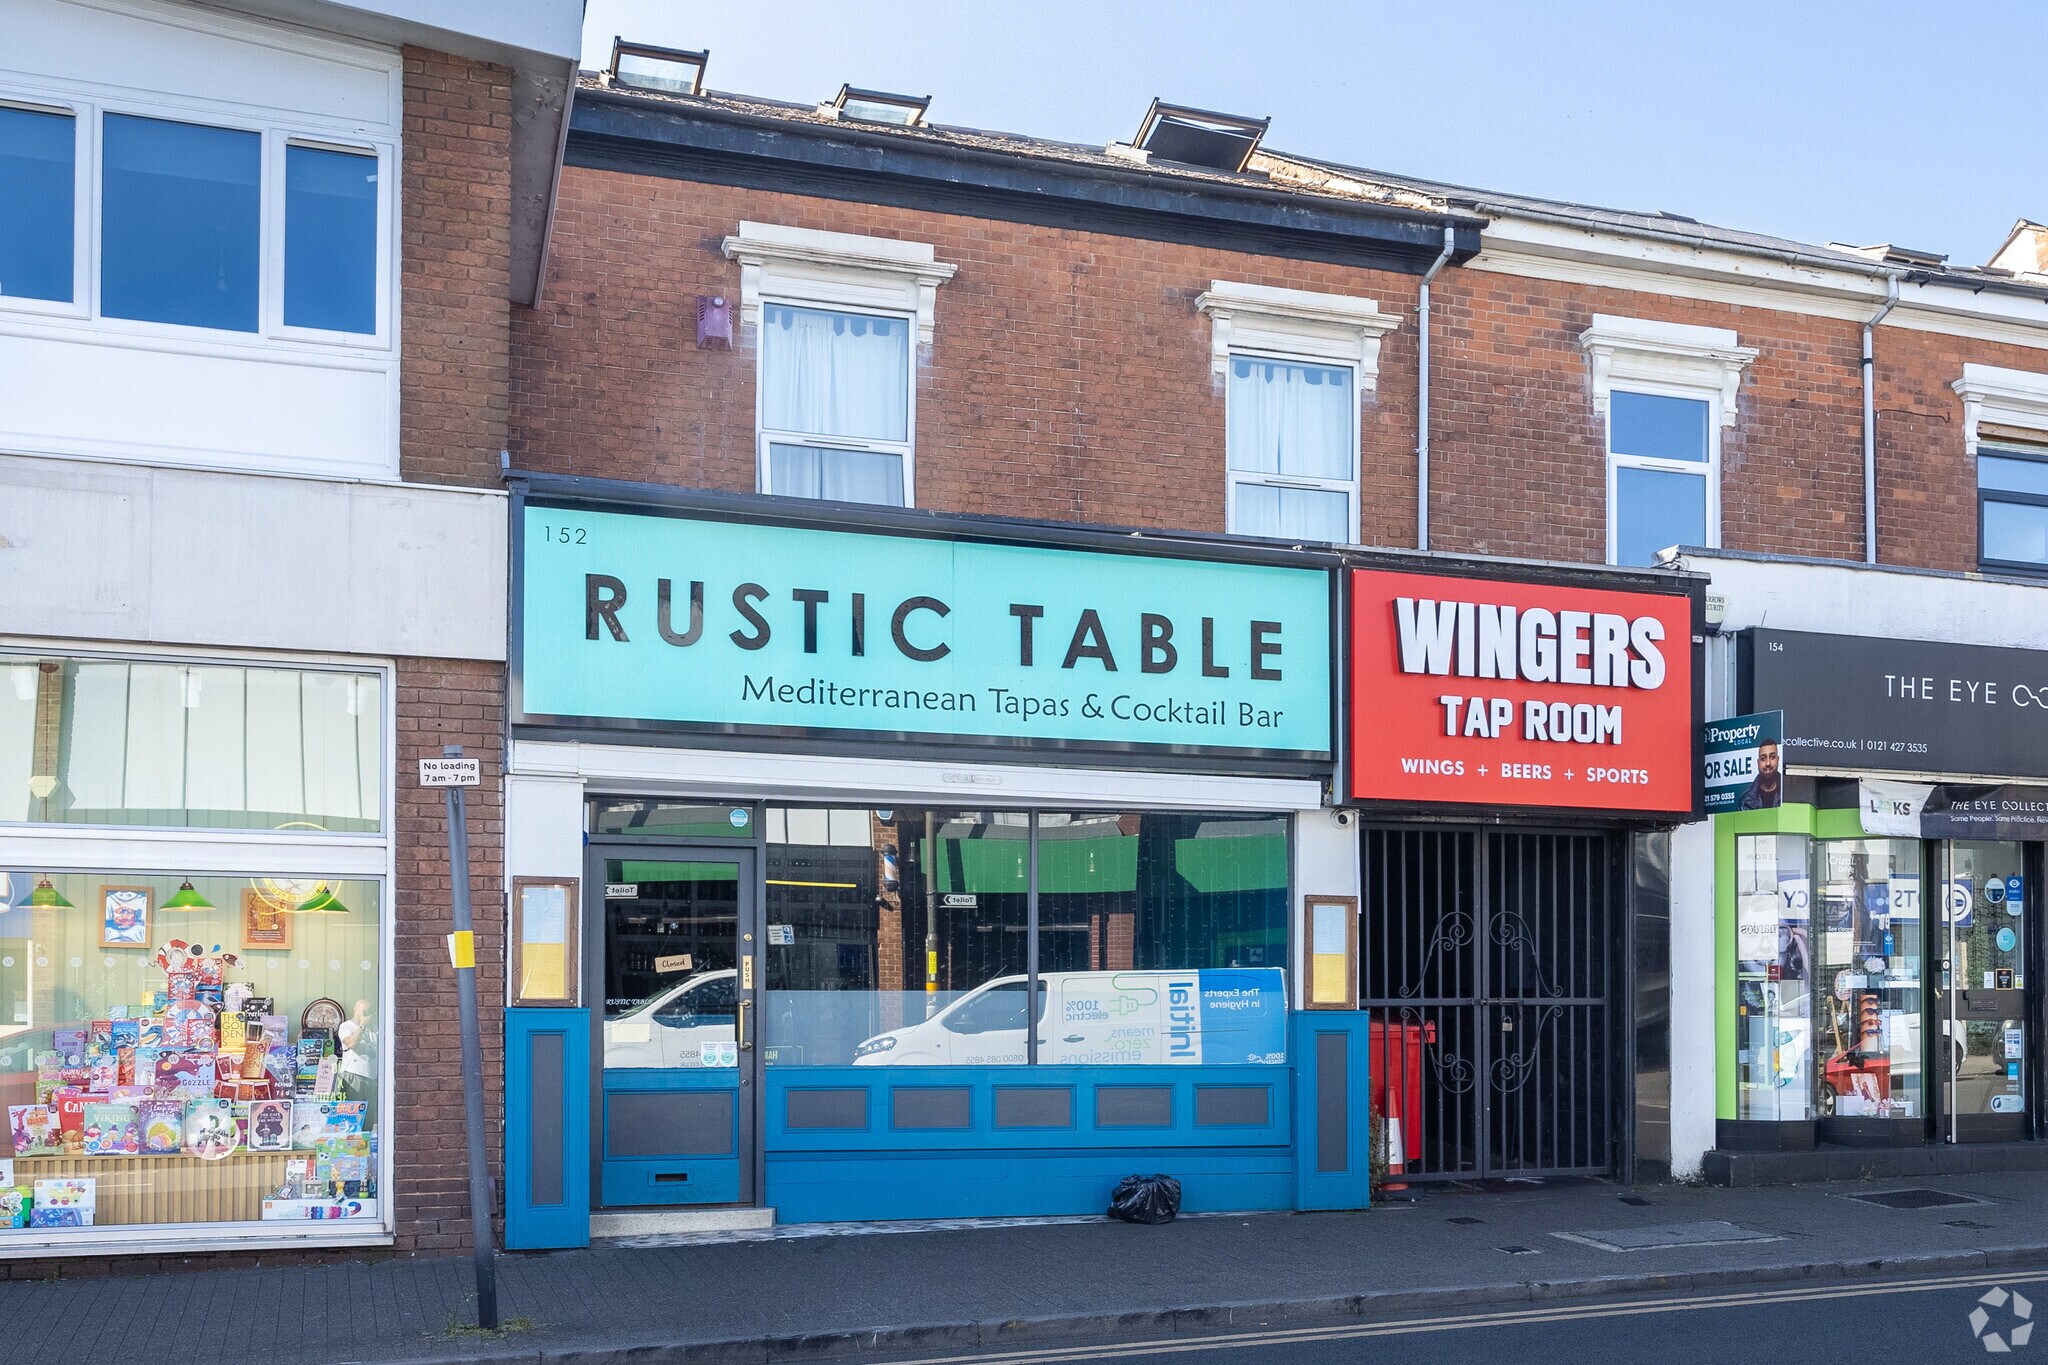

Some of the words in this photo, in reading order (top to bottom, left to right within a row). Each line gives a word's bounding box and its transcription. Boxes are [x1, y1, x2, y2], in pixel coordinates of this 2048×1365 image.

[543, 524, 588, 546] 152
[585, 572, 952, 663] RUSTIC
[1009, 602, 1283, 681] TABLE
[1394, 596, 1667, 691] WINGERS
[1768, 641, 1784, 653] 154
[1884, 674, 1934, 700] THE
[1949, 679, 1998, 705] EYE
[742, 673, 977, 713] Mediterranean
[989, 687, 1070, 719] Tapas
[1082, 695, 1106, 720] &
[1110, 694, 1227, 727] Cocktail
[1238, 703, 1284, 729] Bar
[1438, 694, 1514, 739] TAP
[1523, 699, 1623, 746] ROOM
[1709, 723, 1761, 743] Property
[1733, 738, 1752, 746] LOCAL
[1867, 740, 1887, 751] 0121
[1890, 742, 1906, 752] 427
[1907, 742, 1928, 754] 3535
[424, 762, 438, 770] No
[440, 762, 476, 771] loading
[1400, 757, 1466, 777] WINGS
[1477, 763, 1489, 777] +
[1501, 762, 1553, 781] BEERS
[1563, 768, 1575, 782] +
[1586, 766, 1650, 785] SPORTS
[1704, 760, 1722, 780] OR
[1723, 756, 1753, 778] SALE
[1710, 792, 1720, 801] 579
[1950, 800, 1970, 811] THE
[1974, 800, 1997, 811] EYE
[1950, 815, 1969, 823] Same
[662, 958, 686, 968] Closed
[182, 1079, 211, 1087] GOZZLE
